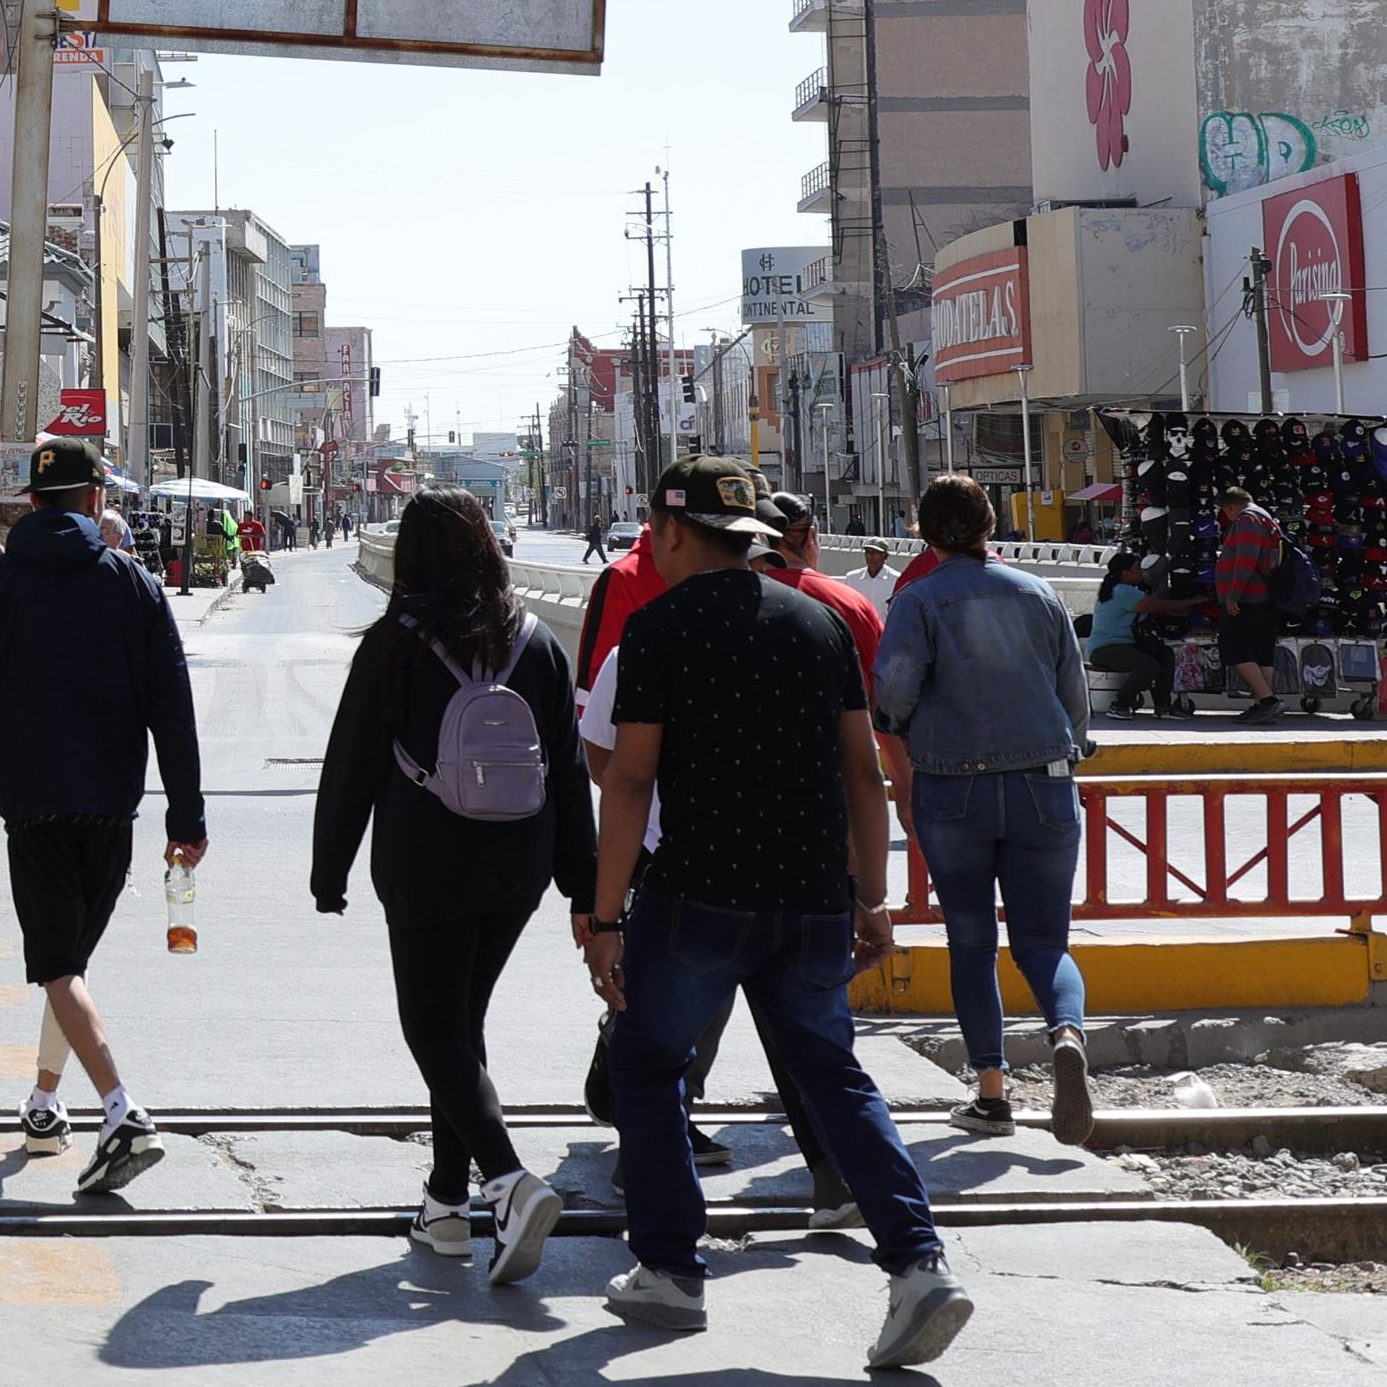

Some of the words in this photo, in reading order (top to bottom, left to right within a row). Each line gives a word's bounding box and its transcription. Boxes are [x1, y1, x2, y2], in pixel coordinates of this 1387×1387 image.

[53, 51, 99, 62] RENDA
[60, 413, 103, 428] Rio
[976, 470, 1018, 482] OPTICAS
